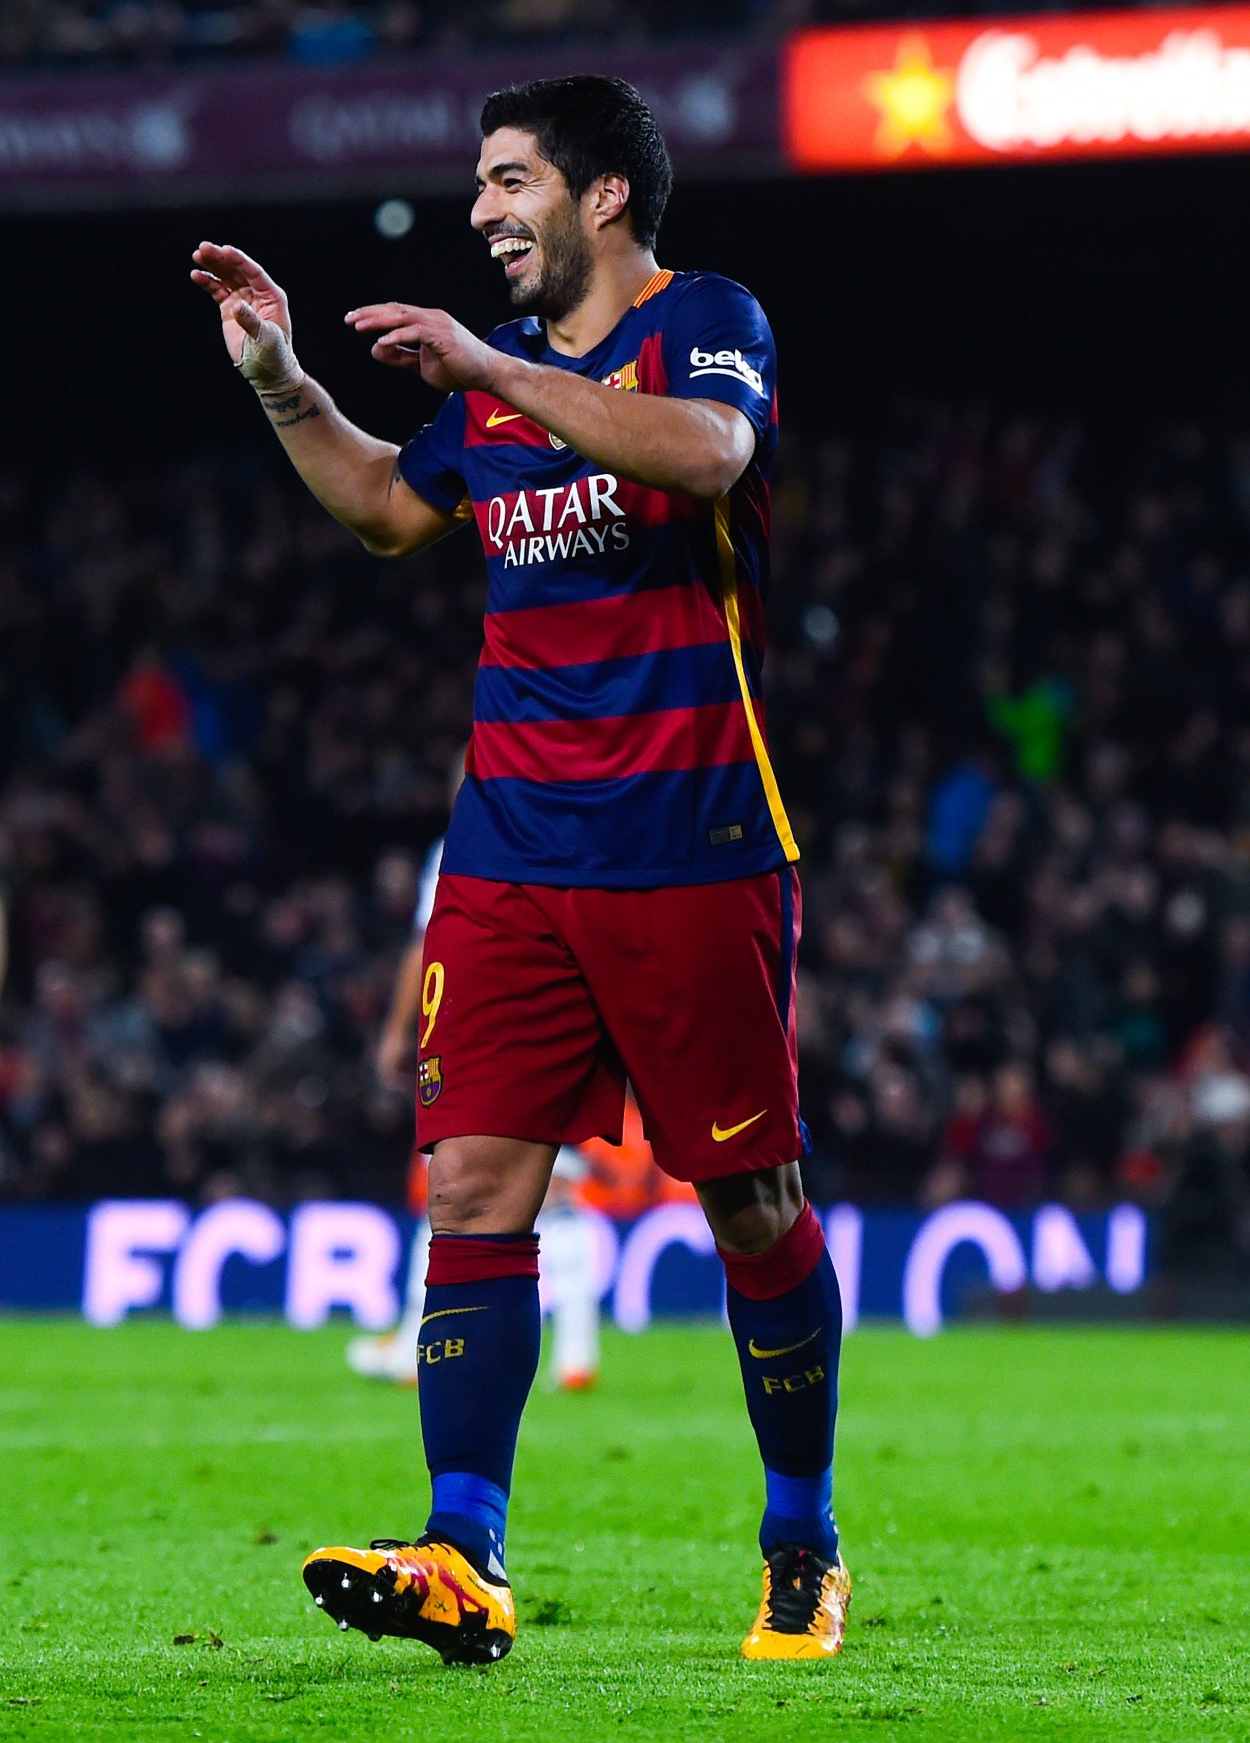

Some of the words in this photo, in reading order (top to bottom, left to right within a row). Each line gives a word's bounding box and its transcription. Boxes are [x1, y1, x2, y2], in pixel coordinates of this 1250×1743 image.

[488, 473, 626, 549] QATAR
[504, 522, 630, 569] AIRWAYS
[421, 962, 445, 1048] 9
[762, 1366, 824, 1394] FCB
